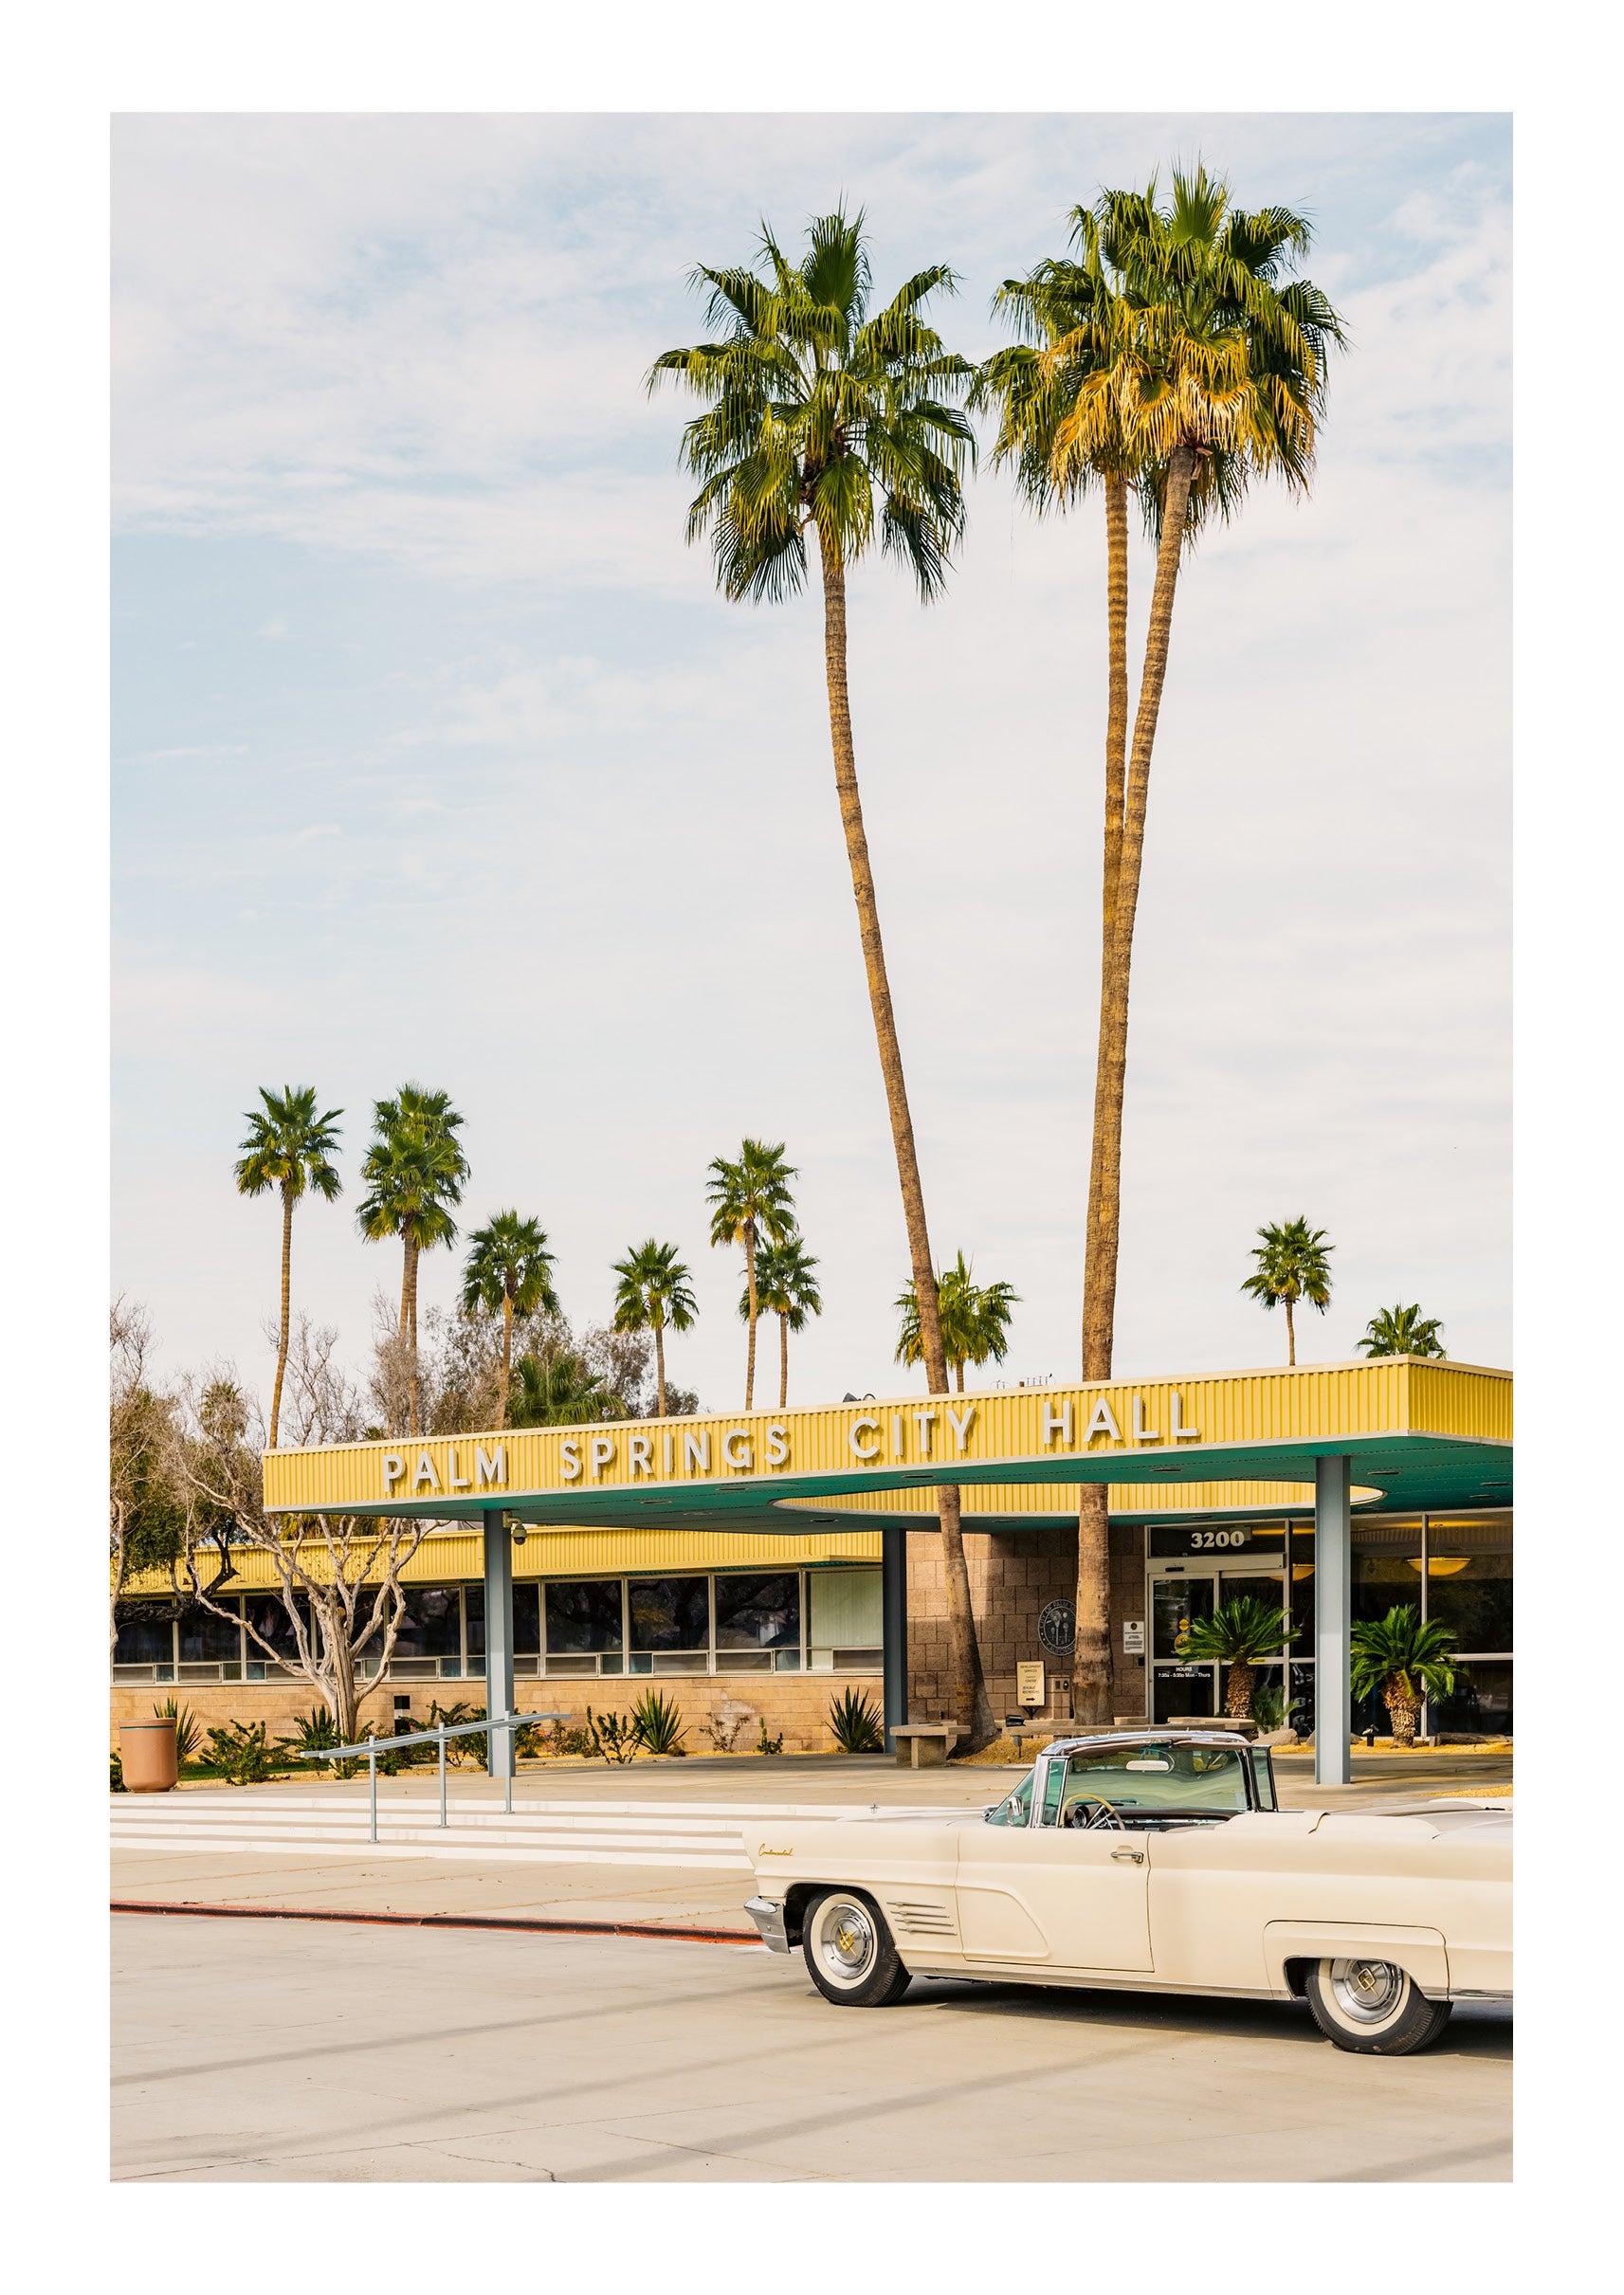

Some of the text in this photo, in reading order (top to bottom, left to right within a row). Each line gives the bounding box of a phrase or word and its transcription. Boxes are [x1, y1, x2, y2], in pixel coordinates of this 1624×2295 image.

[382, 1393, 1199, 1493] PALM SPRINGS CITY HALL
[1191, 1531, 1245, 1548] 3200
